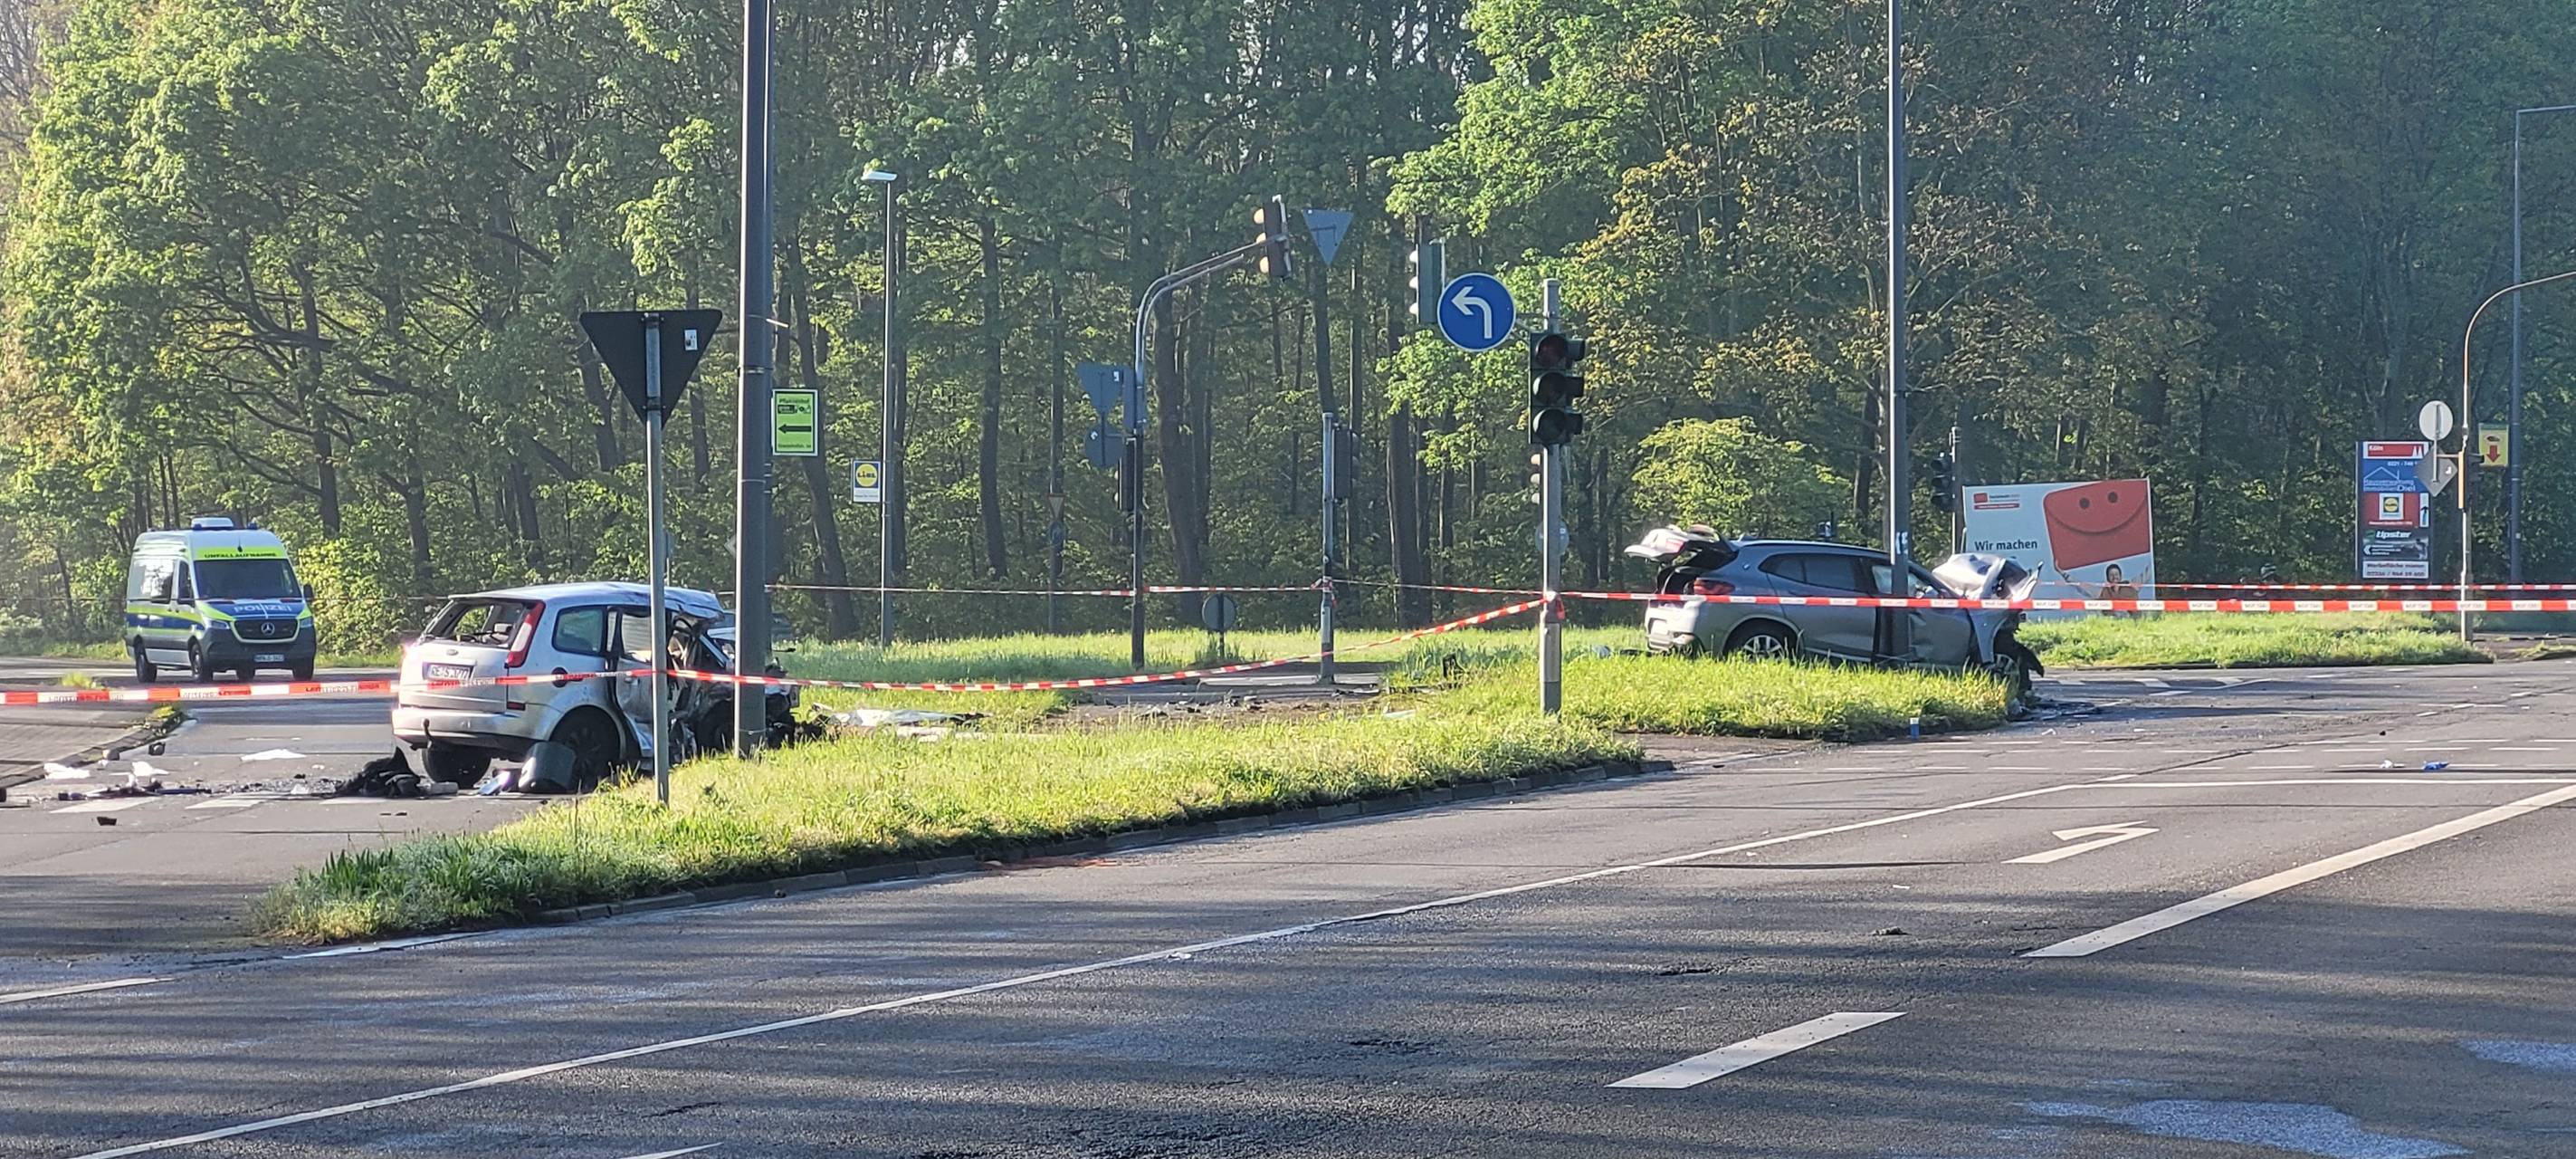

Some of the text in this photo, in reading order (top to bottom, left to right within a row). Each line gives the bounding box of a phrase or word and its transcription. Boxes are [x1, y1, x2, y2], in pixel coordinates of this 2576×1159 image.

[1974, 539, 2037, 551] Wir machen
[234, 604, 291, 612] POLIZEI
